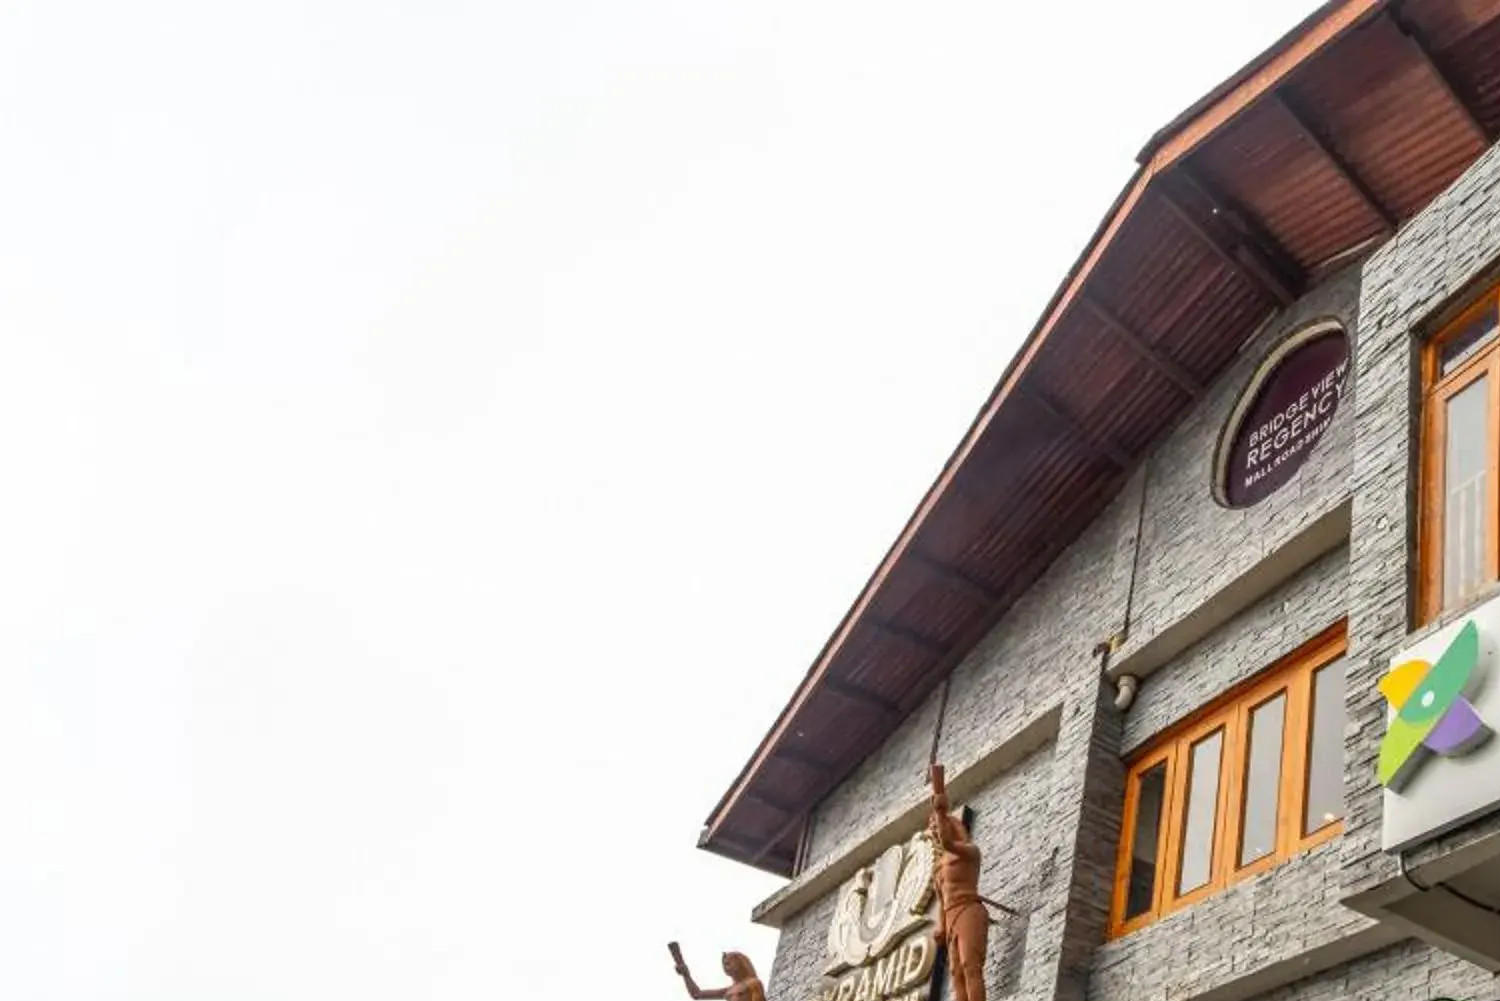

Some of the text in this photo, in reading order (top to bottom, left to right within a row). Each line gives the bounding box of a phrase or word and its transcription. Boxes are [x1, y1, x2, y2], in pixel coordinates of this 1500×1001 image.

[1246, 380, 1344, 468] REGENCY
[1249, 357, 1349, 447] BRIDGE VIEW
[1245, 464, 1273, 487] MALL
